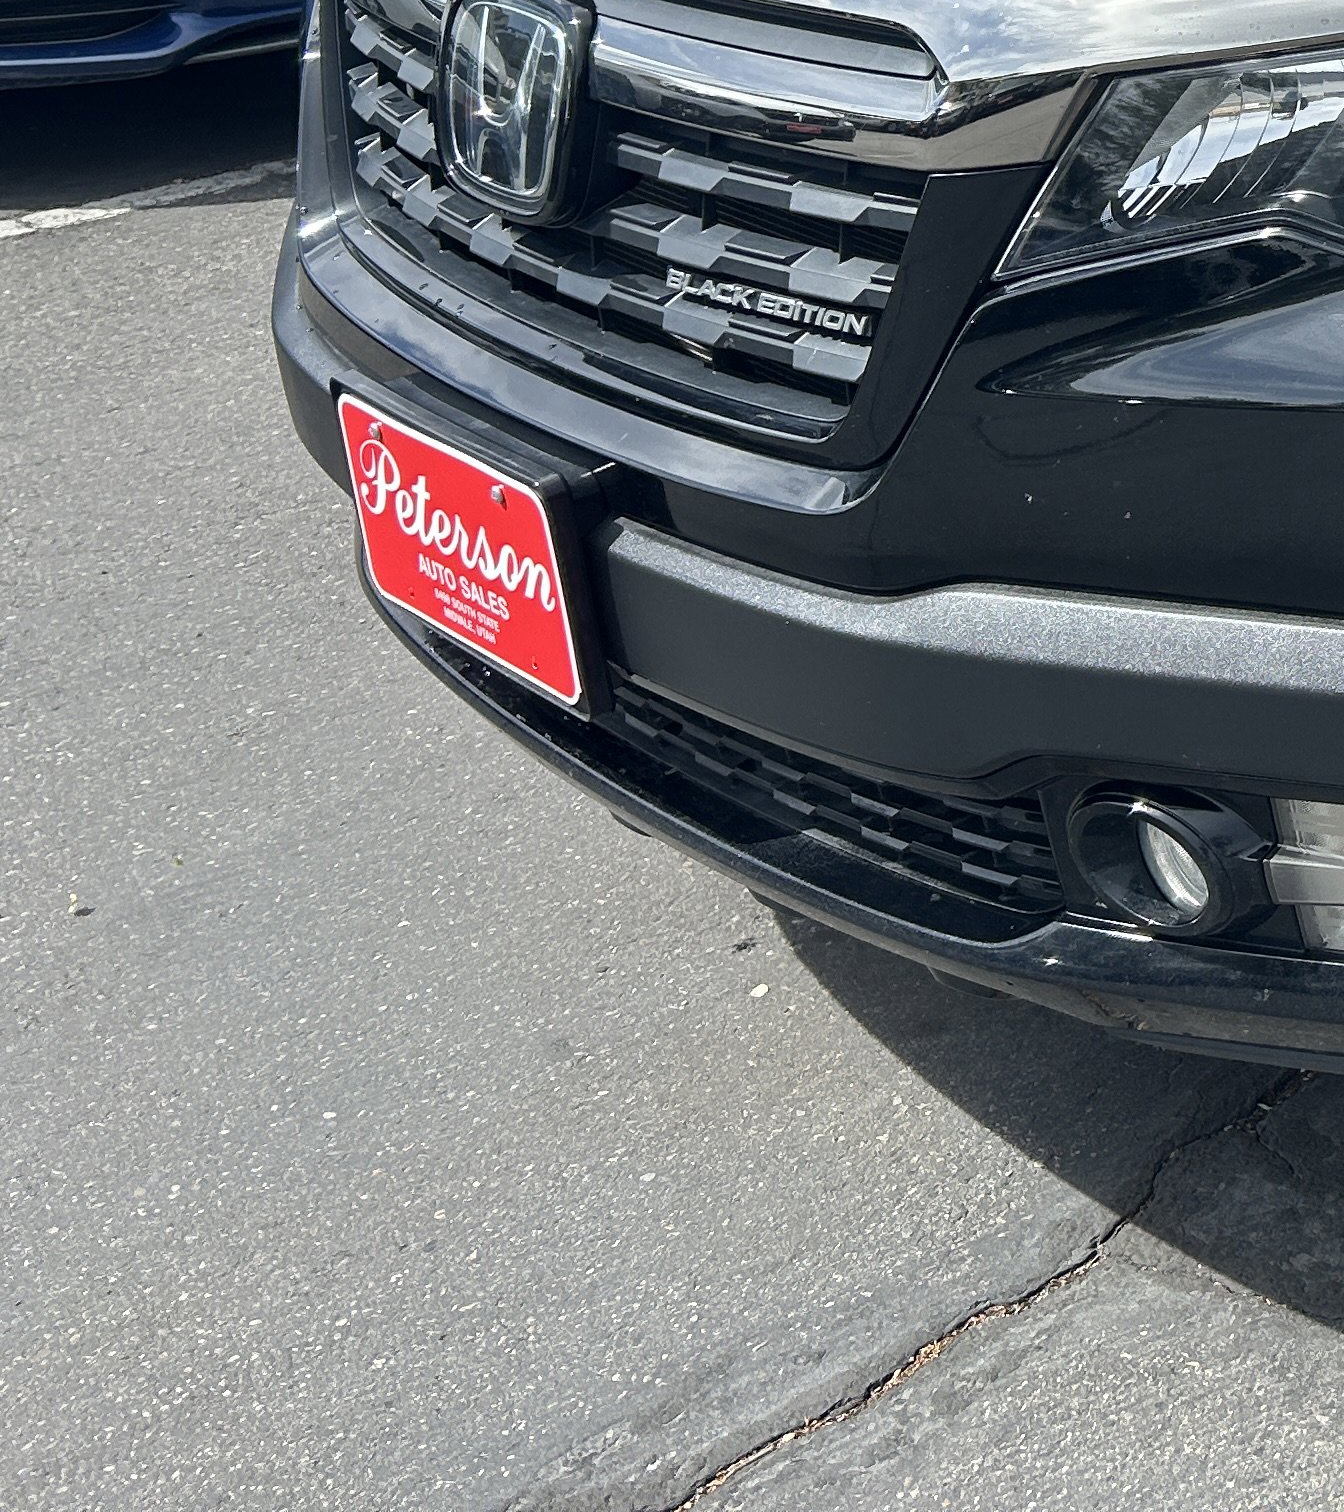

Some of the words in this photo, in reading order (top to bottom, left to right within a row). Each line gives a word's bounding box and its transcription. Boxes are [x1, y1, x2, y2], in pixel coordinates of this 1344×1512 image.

[665, 265, 753, 310] BLACK
[757, 293, 869, 336] EDITION
[358, 438, 556, 612] Peterson
[418, 552, 457, 592] AUTO
[460, 575, 510, 621] SALES
[476, 610, 501, 633] STATE
